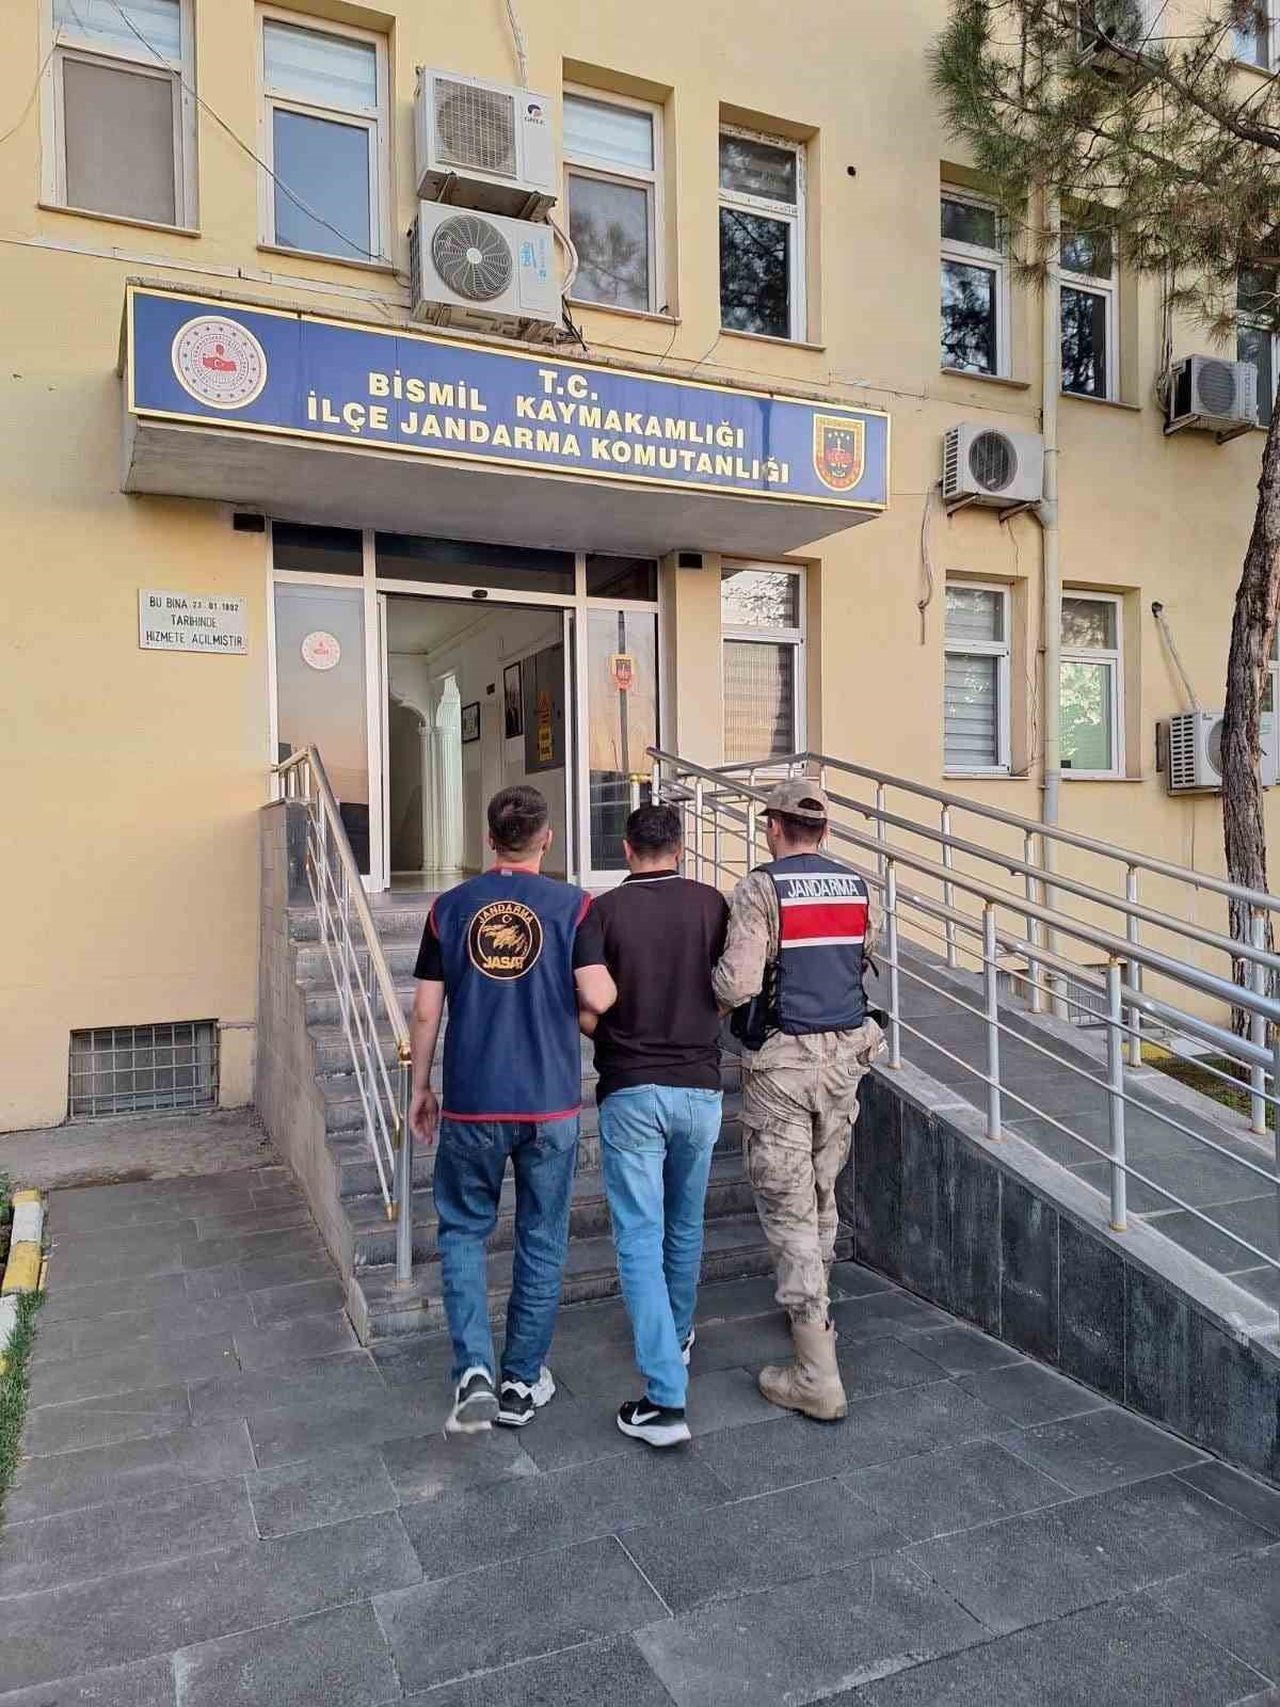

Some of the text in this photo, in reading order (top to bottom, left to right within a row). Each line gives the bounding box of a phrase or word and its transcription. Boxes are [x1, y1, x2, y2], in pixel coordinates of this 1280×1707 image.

[539, 369, 598, 401] T.C.
[368, 369, 744, 449] BİSMİL KAYMAKAMLIĞI
[307, 390, 789, 484] İLÇE JANDARMA KOMUTANLIĞI
[149, 595, 162, 608] BU
[788, 879, 860, 898] JANDARMA
[478, 903, 534, 924] JANDARMA
